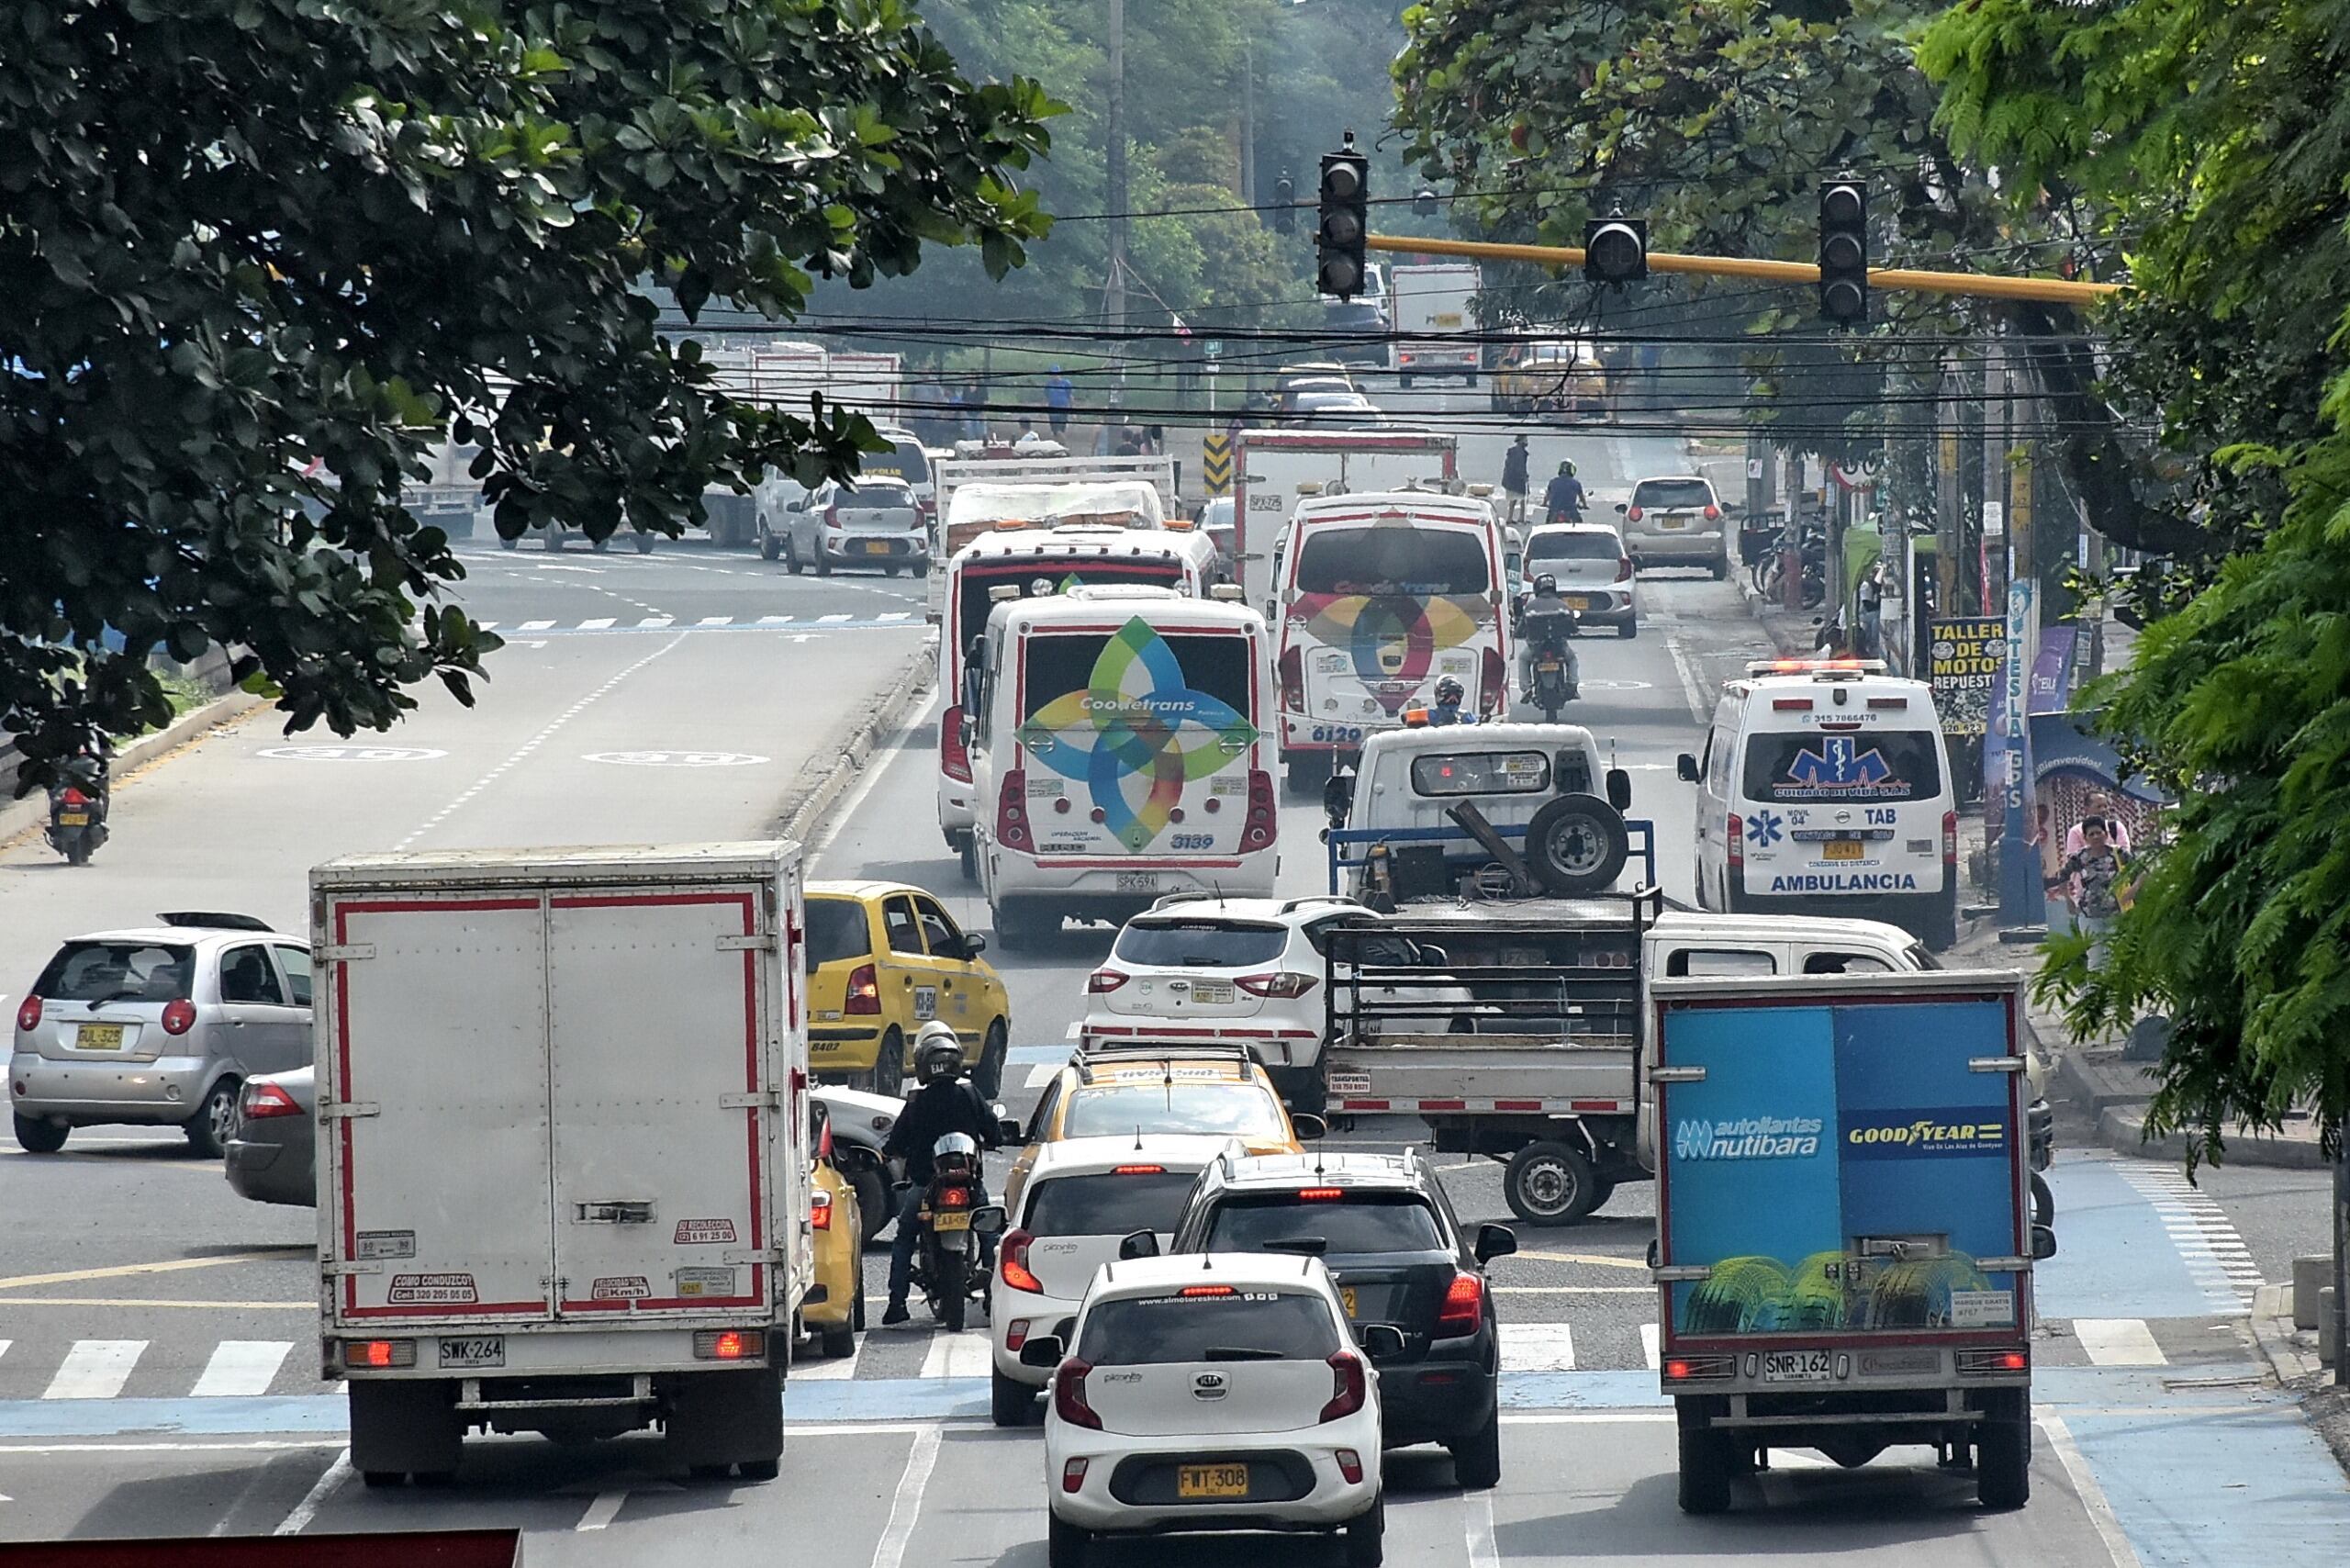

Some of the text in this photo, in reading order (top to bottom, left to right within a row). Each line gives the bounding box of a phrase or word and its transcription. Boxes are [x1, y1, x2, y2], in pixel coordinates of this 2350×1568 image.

[1931, 624, 2004, 640] TALLER
[1956, 642, 1982, 657] DE
[2009, 639, 2023, 809] TESLA GPS
[1312, 725, 1362, 742] 6129
[1792, 816, 1806, 825] 04
[1864, 809, 1896, 824] TAB
[1169, 833, 1214, 850] 3139
[1771, 873, 1917, 891] AMBULANCIA
[1713, 1117, 1822, 1137] autollantas
[1849, 1122, 1975, 1146] GOODYEAR
[1710, 1135, 1818, 1158] nutibara
[395, 1275, 472, 1286] COMO CONDUZCO?
[416, 1290, 431, 1299] 320
[433, 1290, 448, 1299] 205
[450, 1289, 460, 1299] 05
[462, 1289, 472, 1299] 05
[610, 1287, 644, 1296] Km/h
[1138, 1294, 1241, 1306] www.almotoreskia.com
[1200, 1377, 1221, 1385] KIA
